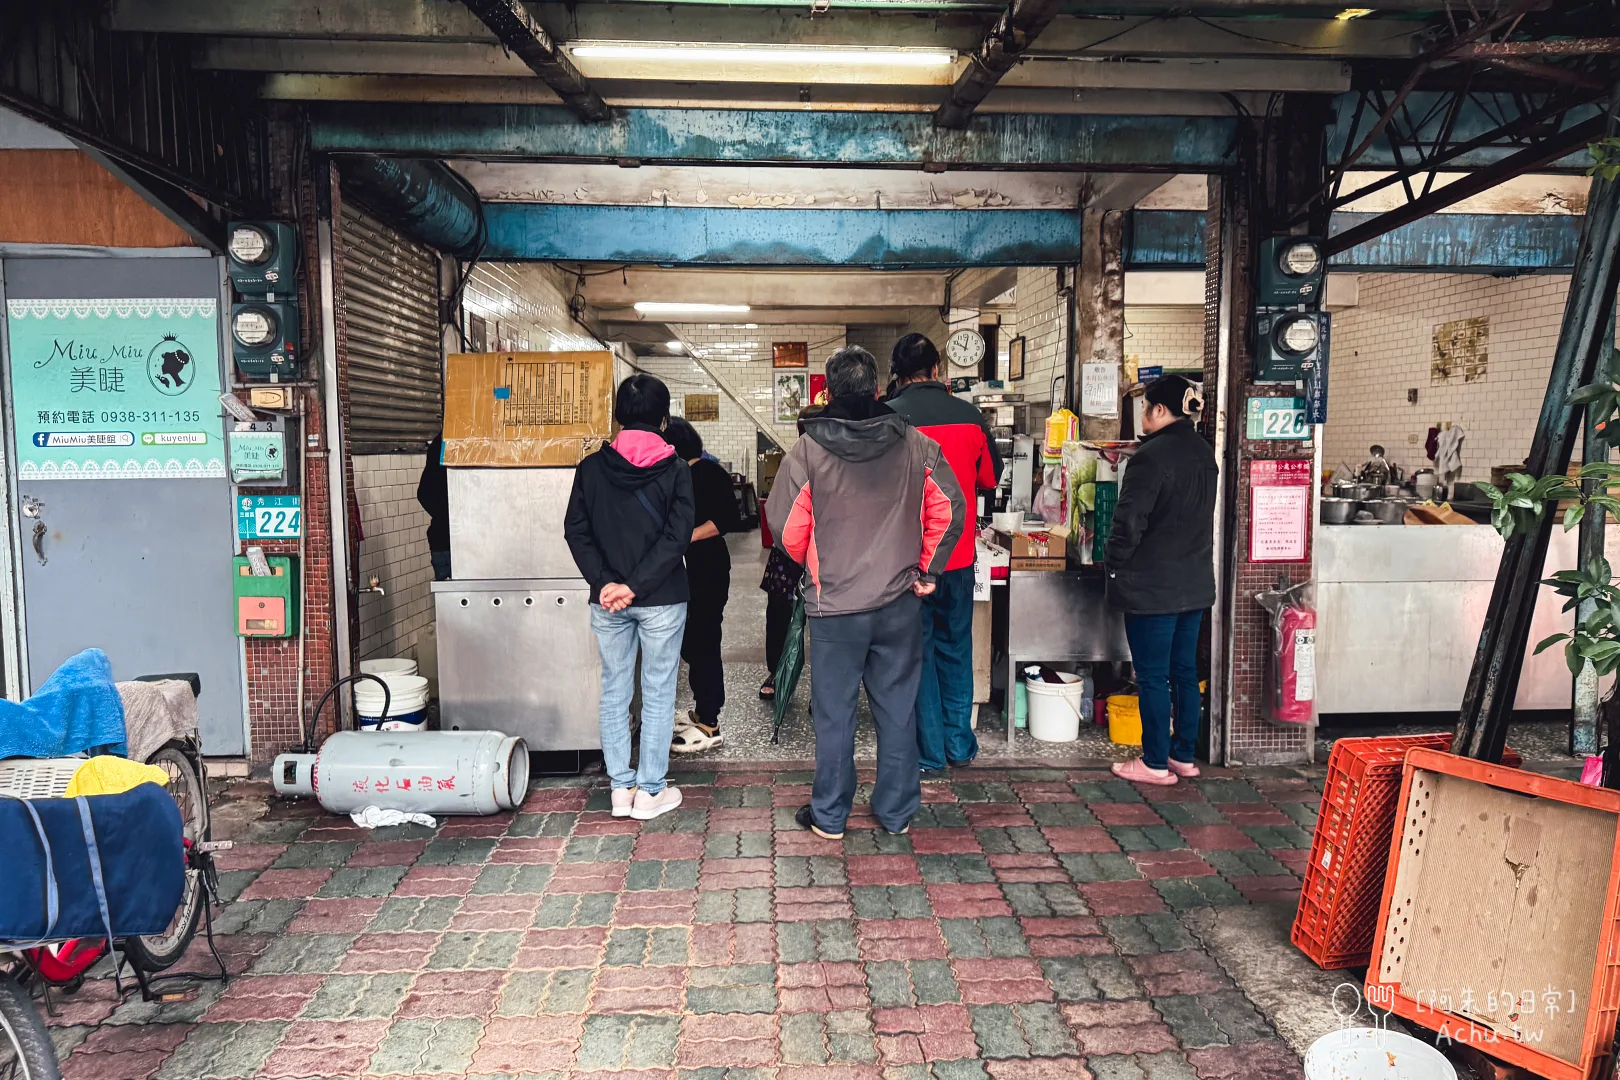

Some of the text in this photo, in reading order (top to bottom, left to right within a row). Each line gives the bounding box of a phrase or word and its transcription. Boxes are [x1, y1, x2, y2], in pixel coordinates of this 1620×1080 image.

[34, 338, 143, 369] Miu Miu
[70, 366, 126, 393] 美睫
[37, 410, 200, 424] 預約電話 0938-311-135
[266, 422, 273, 431] 3
[1266, 412, 1305, 435] 226
[160, 434, 197, 444] kuyenju
[259, 511, 300, 533] 224
